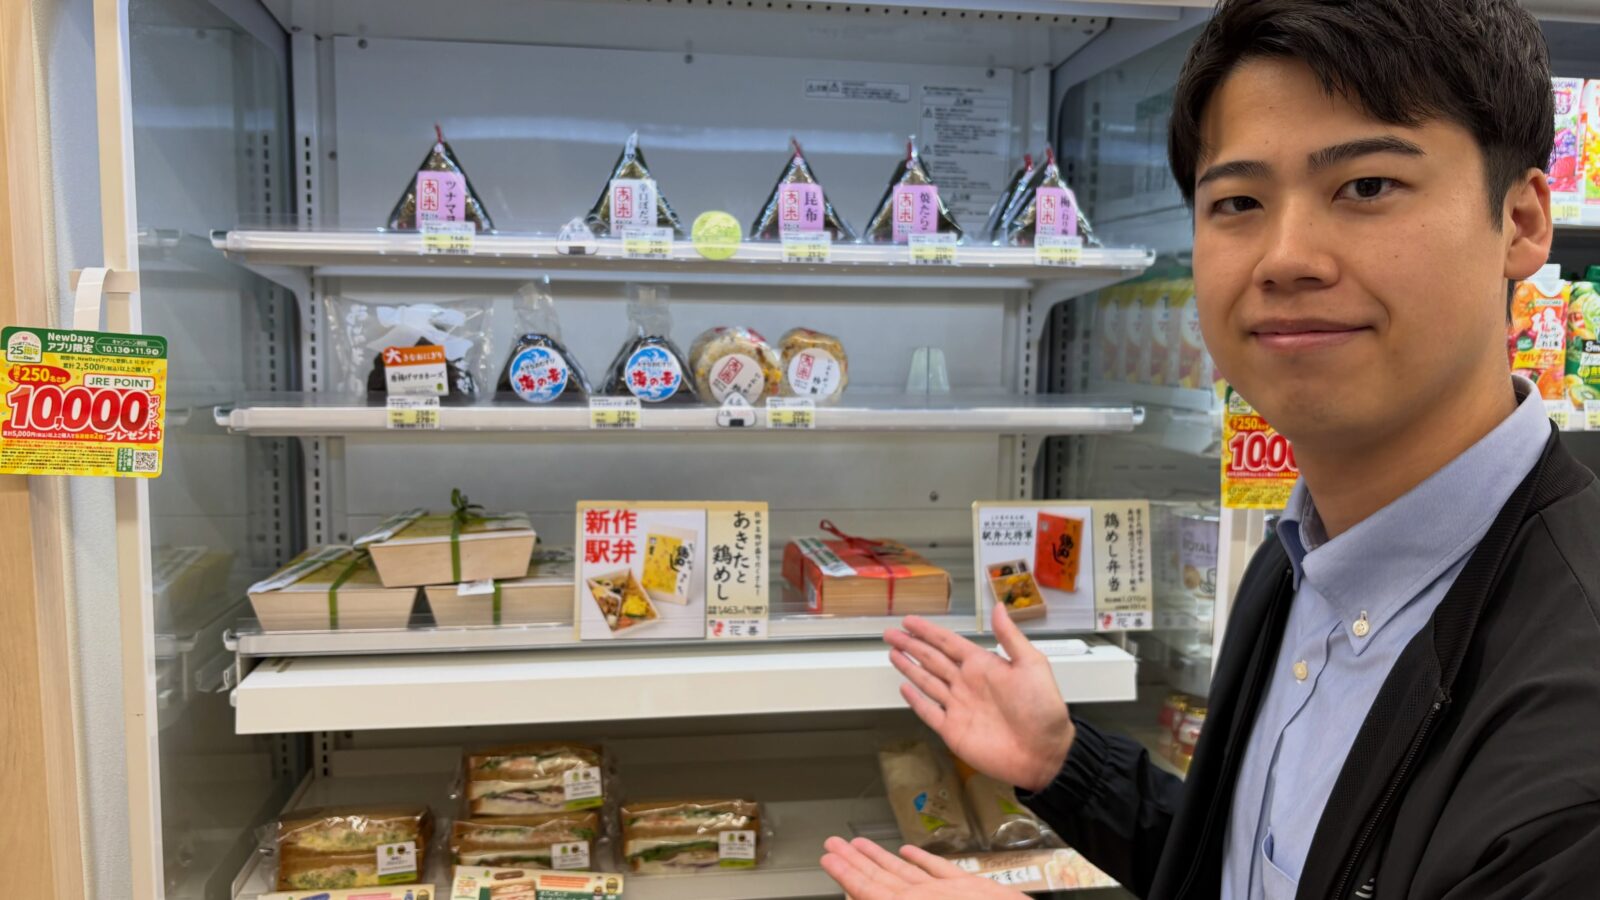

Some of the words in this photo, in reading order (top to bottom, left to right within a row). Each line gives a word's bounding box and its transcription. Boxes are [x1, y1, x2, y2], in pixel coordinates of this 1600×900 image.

[805, 191, 818, 223] 昆布
[47, 332, 95, 345] NewDays
[47, 342, 94, 354] アプリ限定
[88, 377, 110, 387] JRE
[113, 378, 151, 388] POINT
[8, 386, 149, 434] 10,000
[149, 396, 160, 430] ポイント
[585, 509, 637, 534] 新作
[982, 529, 1033, 542] 駅弁大将軍
[585, 538, 637, 563] 駅弁
[733, 510, 751, 584] あきたと
[1103, 512, 1120, 593] 鶏めし弁当
[712, 544, 733, 601] 鶏めし
